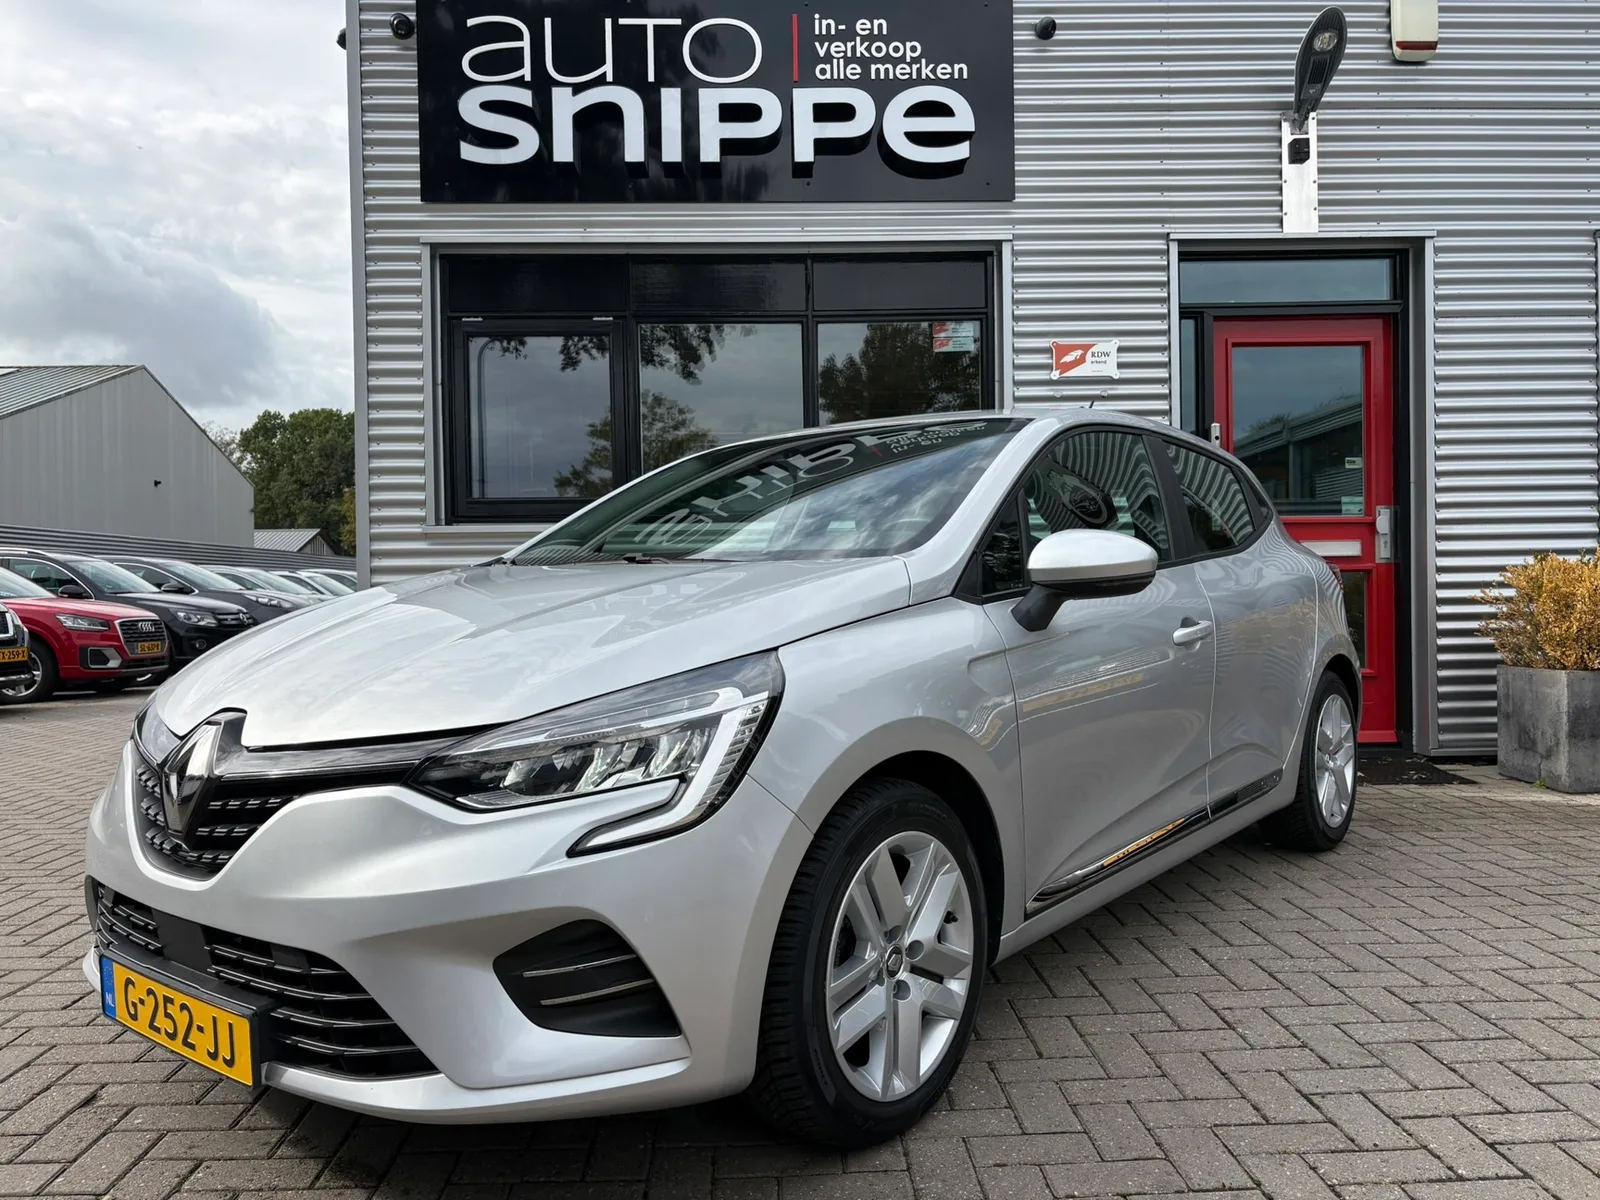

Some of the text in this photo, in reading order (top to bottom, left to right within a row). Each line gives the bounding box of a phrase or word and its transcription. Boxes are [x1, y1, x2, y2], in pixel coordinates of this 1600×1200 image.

[814, 13, 888, 35] in- en
[814, 36, 922, 62] verkoop
[815, 58, 968, 80] alle merken
[105, 991, 115, 1008] NL
[124, 976, 236, 1068] G-252-JJ
